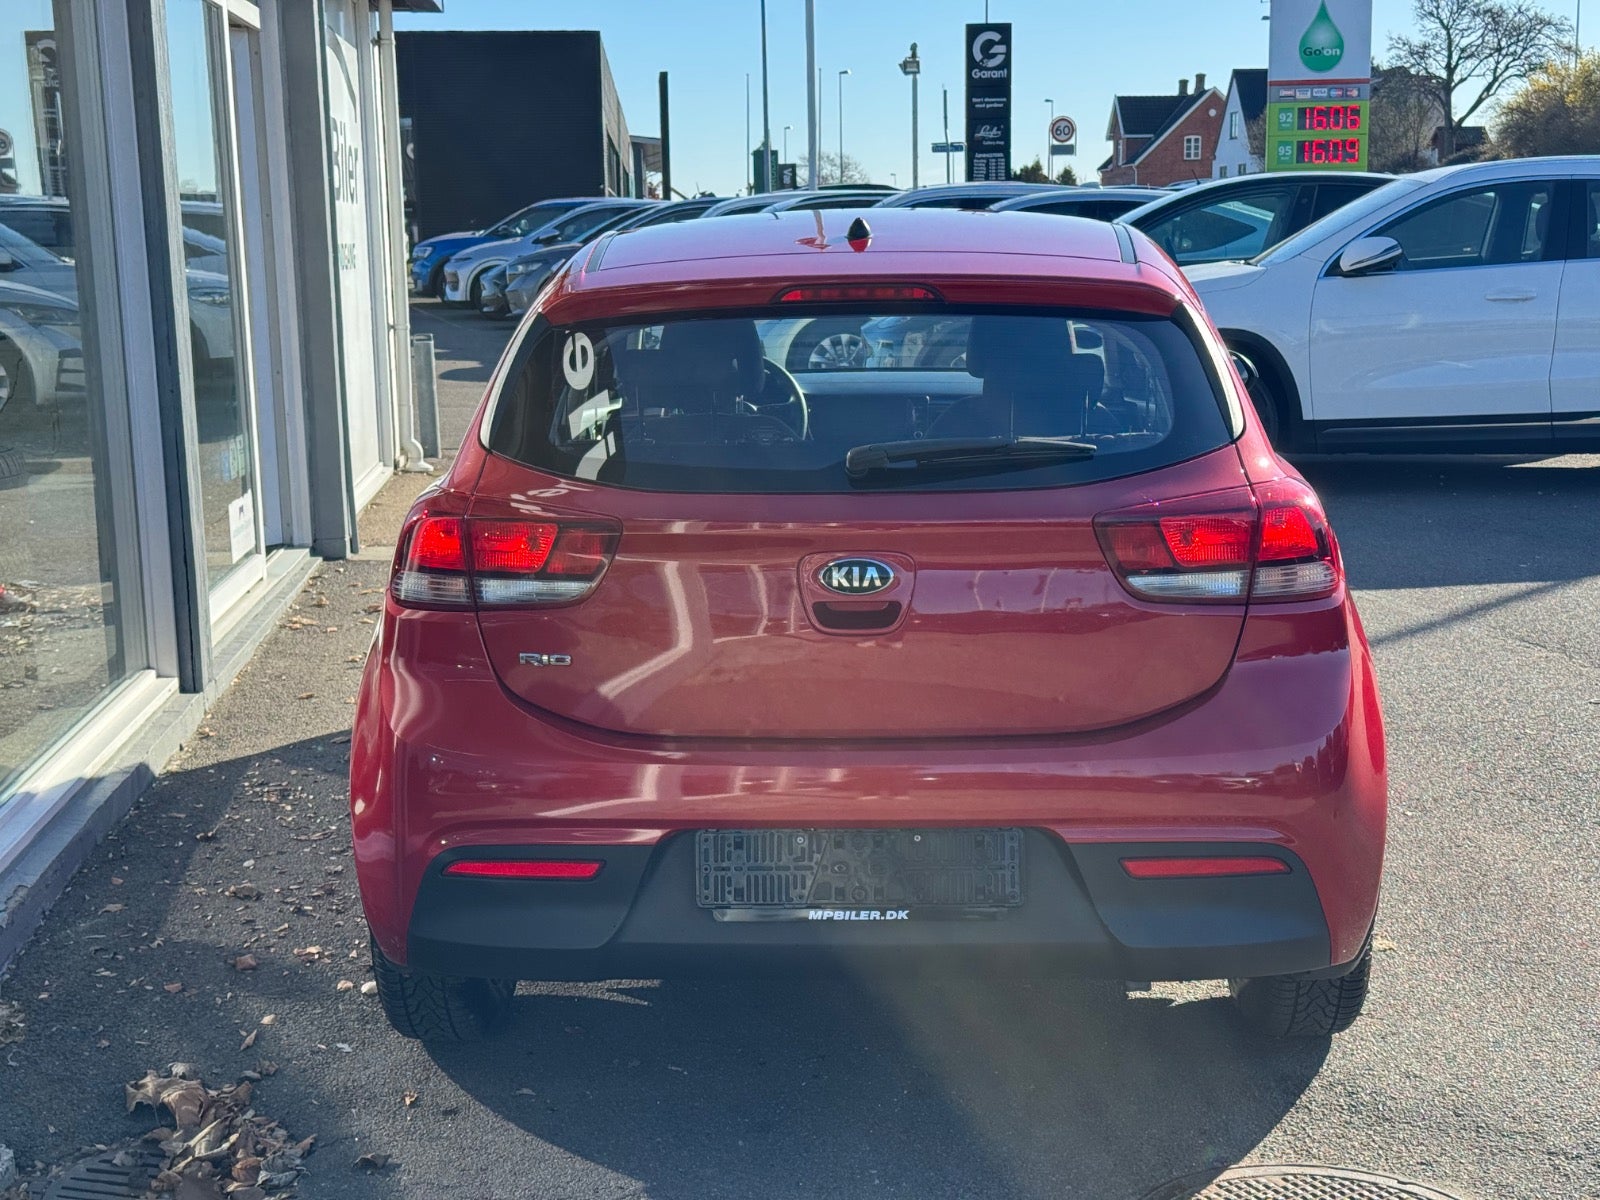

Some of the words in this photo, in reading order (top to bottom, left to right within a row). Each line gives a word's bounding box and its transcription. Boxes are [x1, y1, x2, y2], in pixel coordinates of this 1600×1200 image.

[1303, 47, 1340, 57] Go'on
[972, 69, 1007, 79] Garant
[1279, 113, 1293, 122] 92
[1305, 105, 1360, 130] 16.06
[1055, 124, 1071, 136] 60
[1278, 146, 1292, 155] 95
[1304, 138, 1360, 164] 16.09
[330, 116, 358, 204] Biler
[830, 565, 884, 590] KIA
[519, 652, 571, 667] RIO
[808, 909, 910, 921] MPBILER.DK
